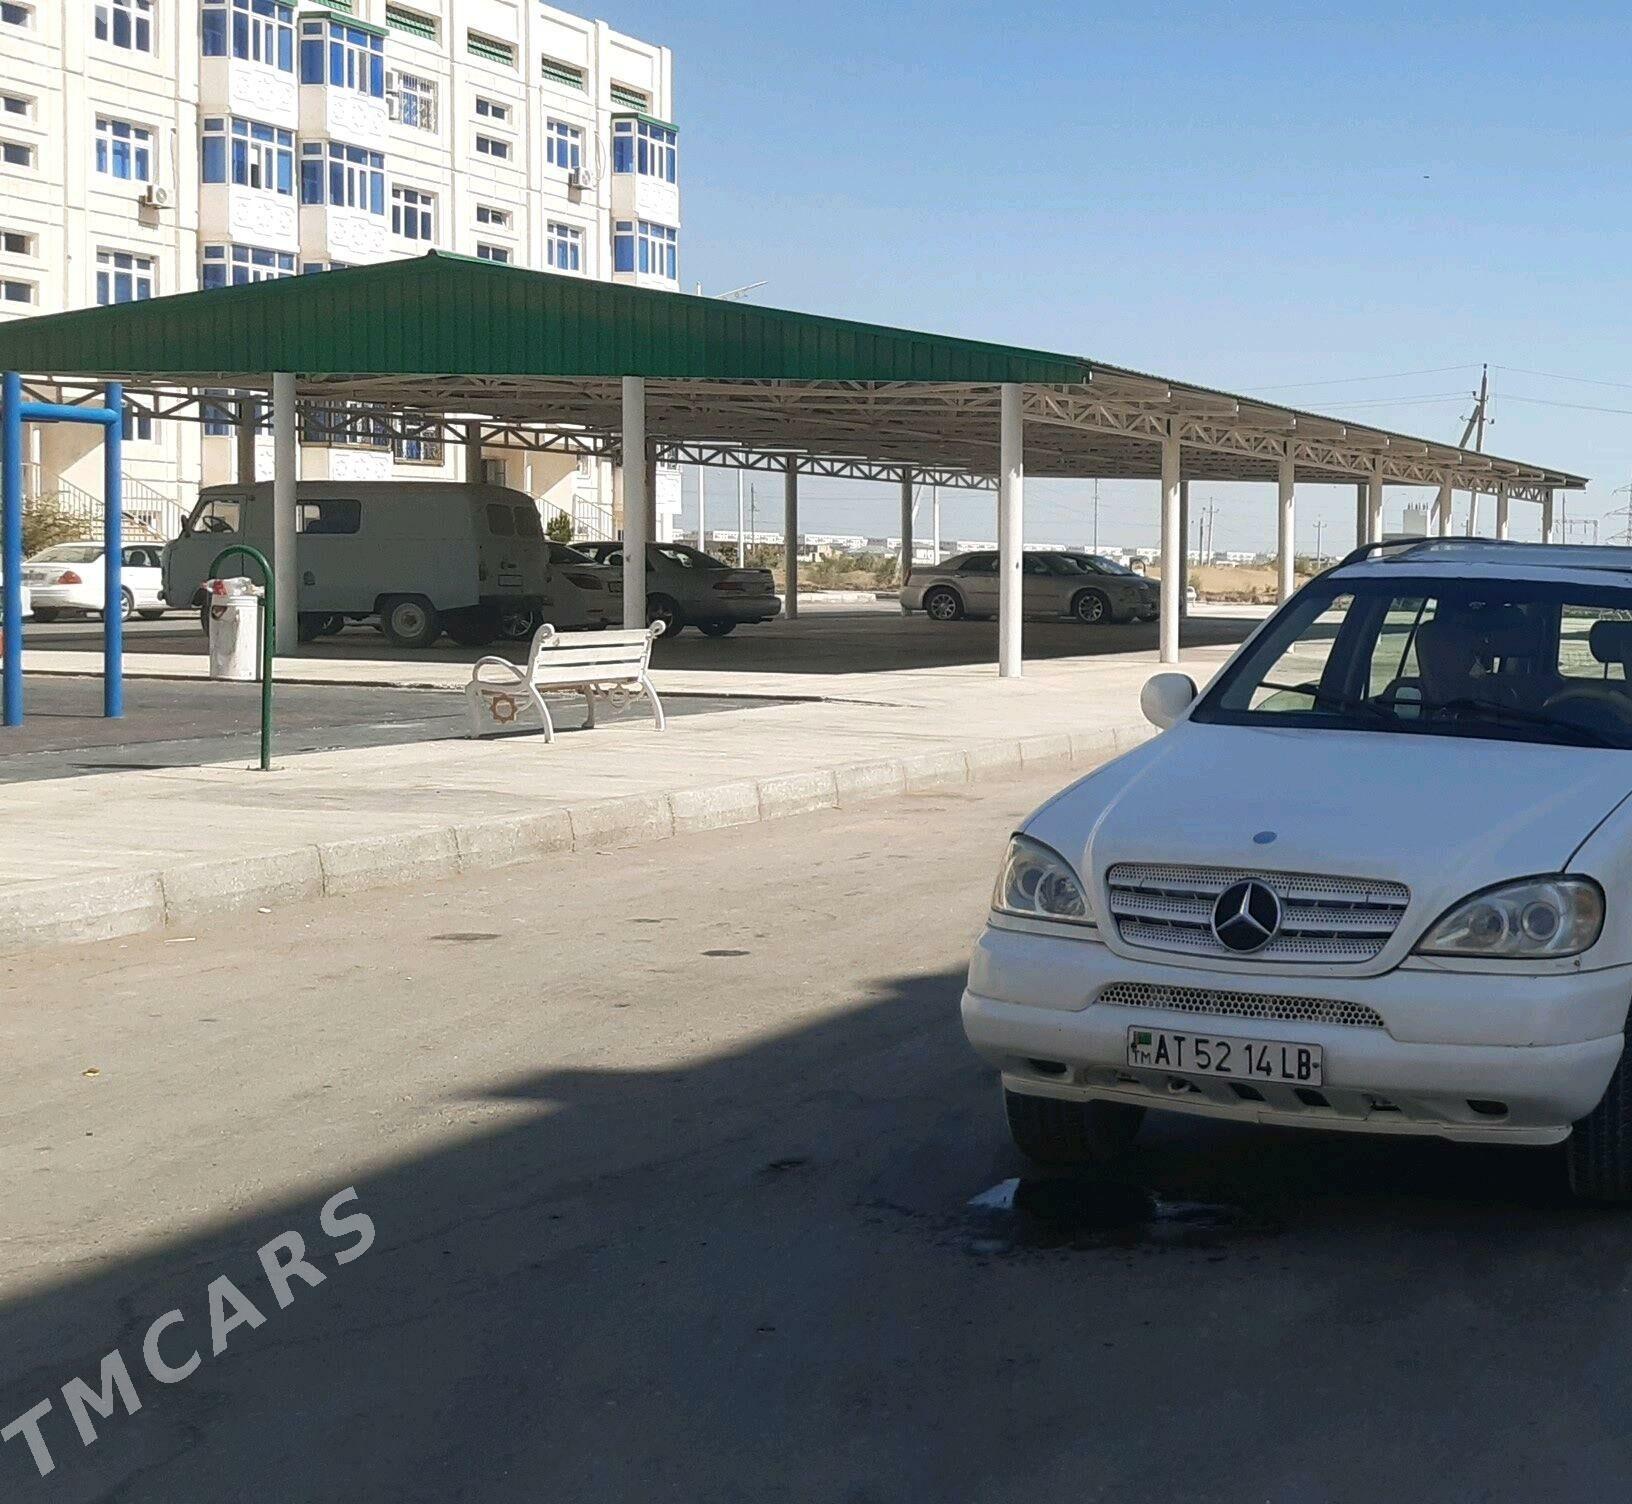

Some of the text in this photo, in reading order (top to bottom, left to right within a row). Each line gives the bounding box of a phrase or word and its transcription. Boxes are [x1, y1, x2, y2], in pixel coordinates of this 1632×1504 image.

[1133, 1050, 1151, 1065] TM
[1154, 1033, 1312, 1081] AT 52 14 LB
